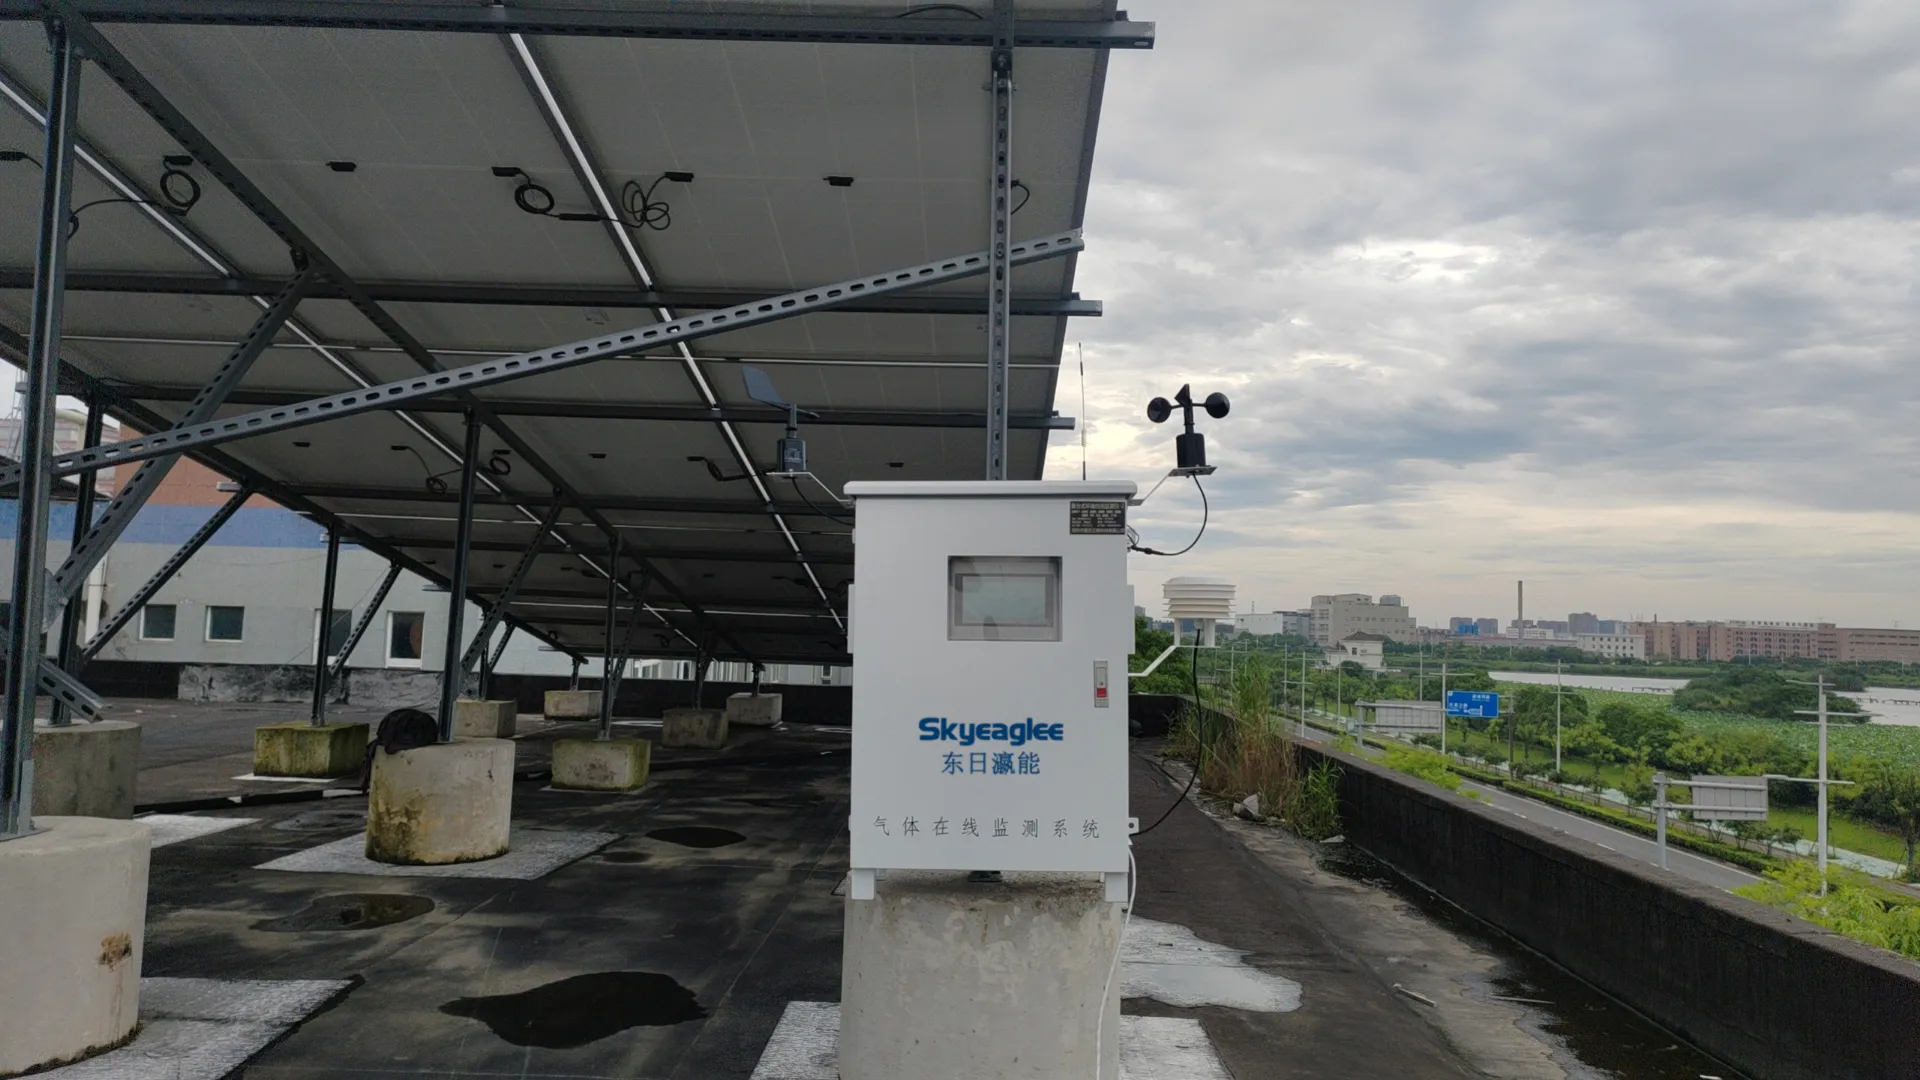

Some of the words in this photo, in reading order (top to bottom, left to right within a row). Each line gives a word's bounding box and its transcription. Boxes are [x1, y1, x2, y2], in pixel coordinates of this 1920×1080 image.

[918, 717, 1064, 746] Skyeaglee
[941, 751, 1041, 775] 东日瀛能
[873, 815, 1100, 840] 气体在线监测系统
